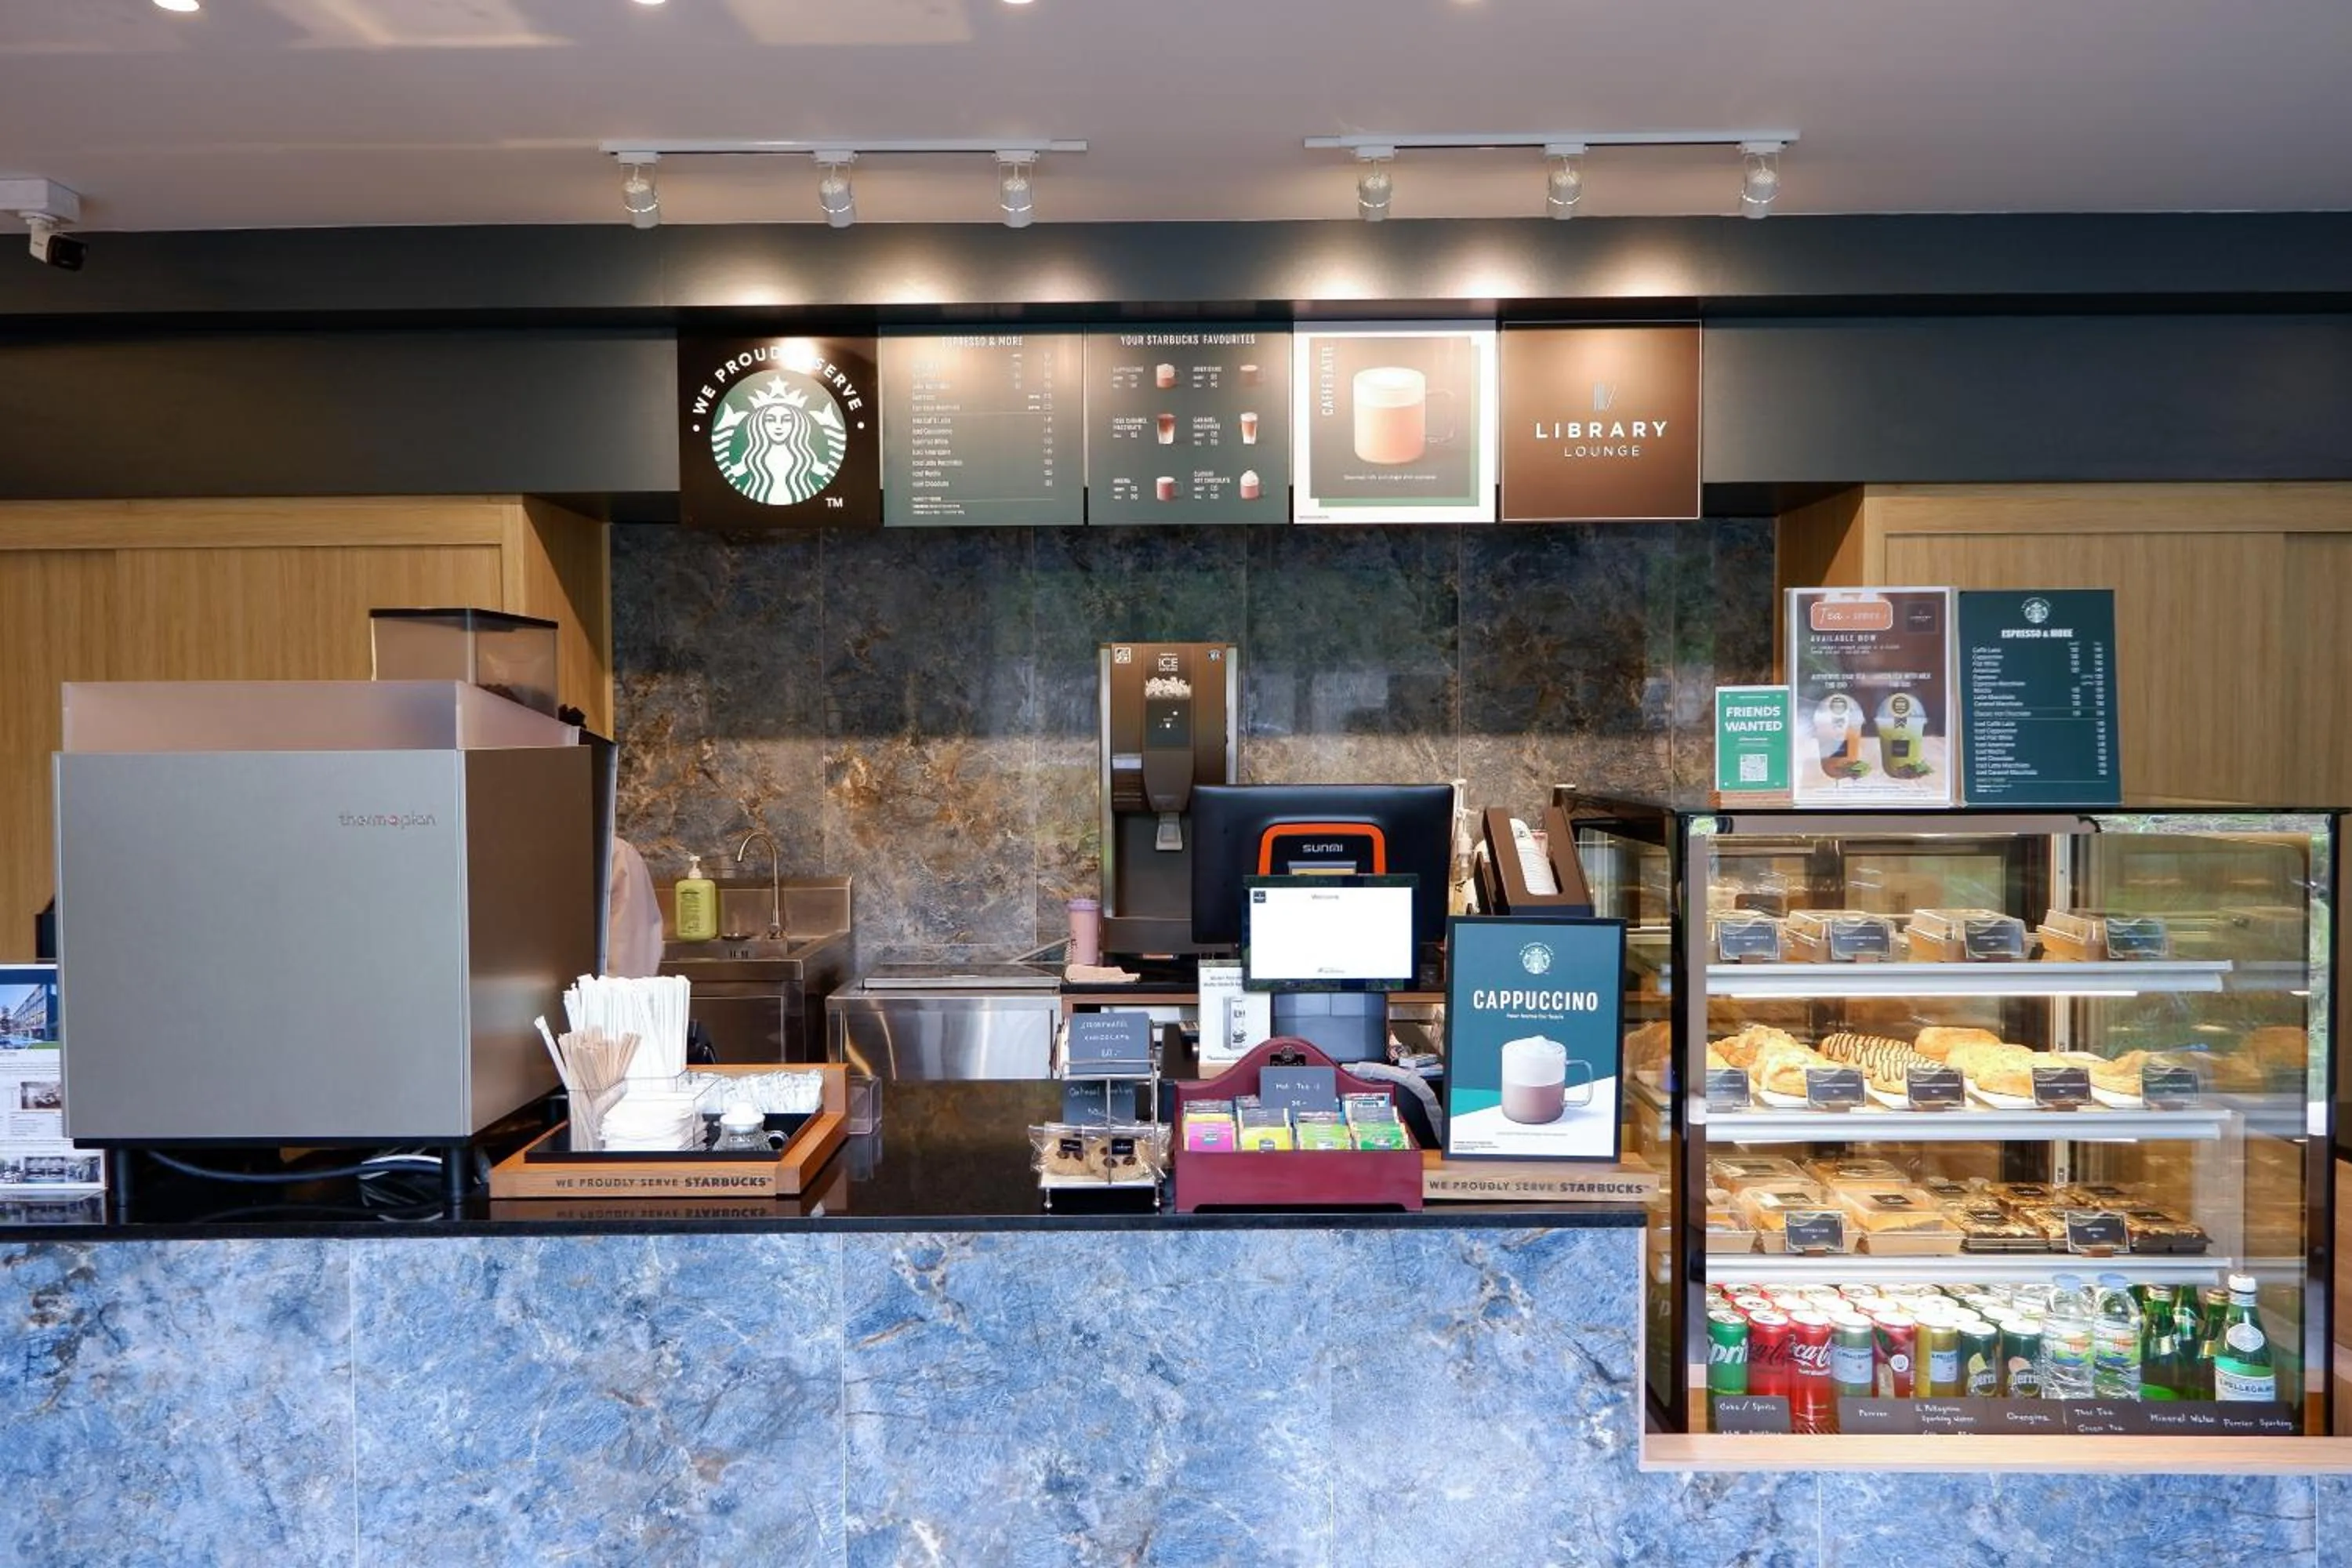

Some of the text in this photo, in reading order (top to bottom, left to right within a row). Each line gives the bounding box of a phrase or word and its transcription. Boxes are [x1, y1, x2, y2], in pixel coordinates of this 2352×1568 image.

[1120, 334, 1255, 346] YOUR STARBUCKS FAVOURITES
[693, 385, 716, 416] WE
[815, 357, 862, 411] SERVE
[1536, 421, 1667, 438] LIBRARY
[1564, 445, 1641, 457] LOUNGE
[826, 497, 843, 508] TM
[1158, 657, 1178, 666] ICE
[1726, 706, 1780, 717] FRIENDS
[1725, 720, 1782, 731] WANTED
[1473, 989, 1599, 1011] CAPPUCCINO
[556, 1177, 766, 1187] WE PROUDLY SERVE STARBUCKS
[1429, 1180, 1644, 1194] WE PROUDLY SERVE STARBUCKS
